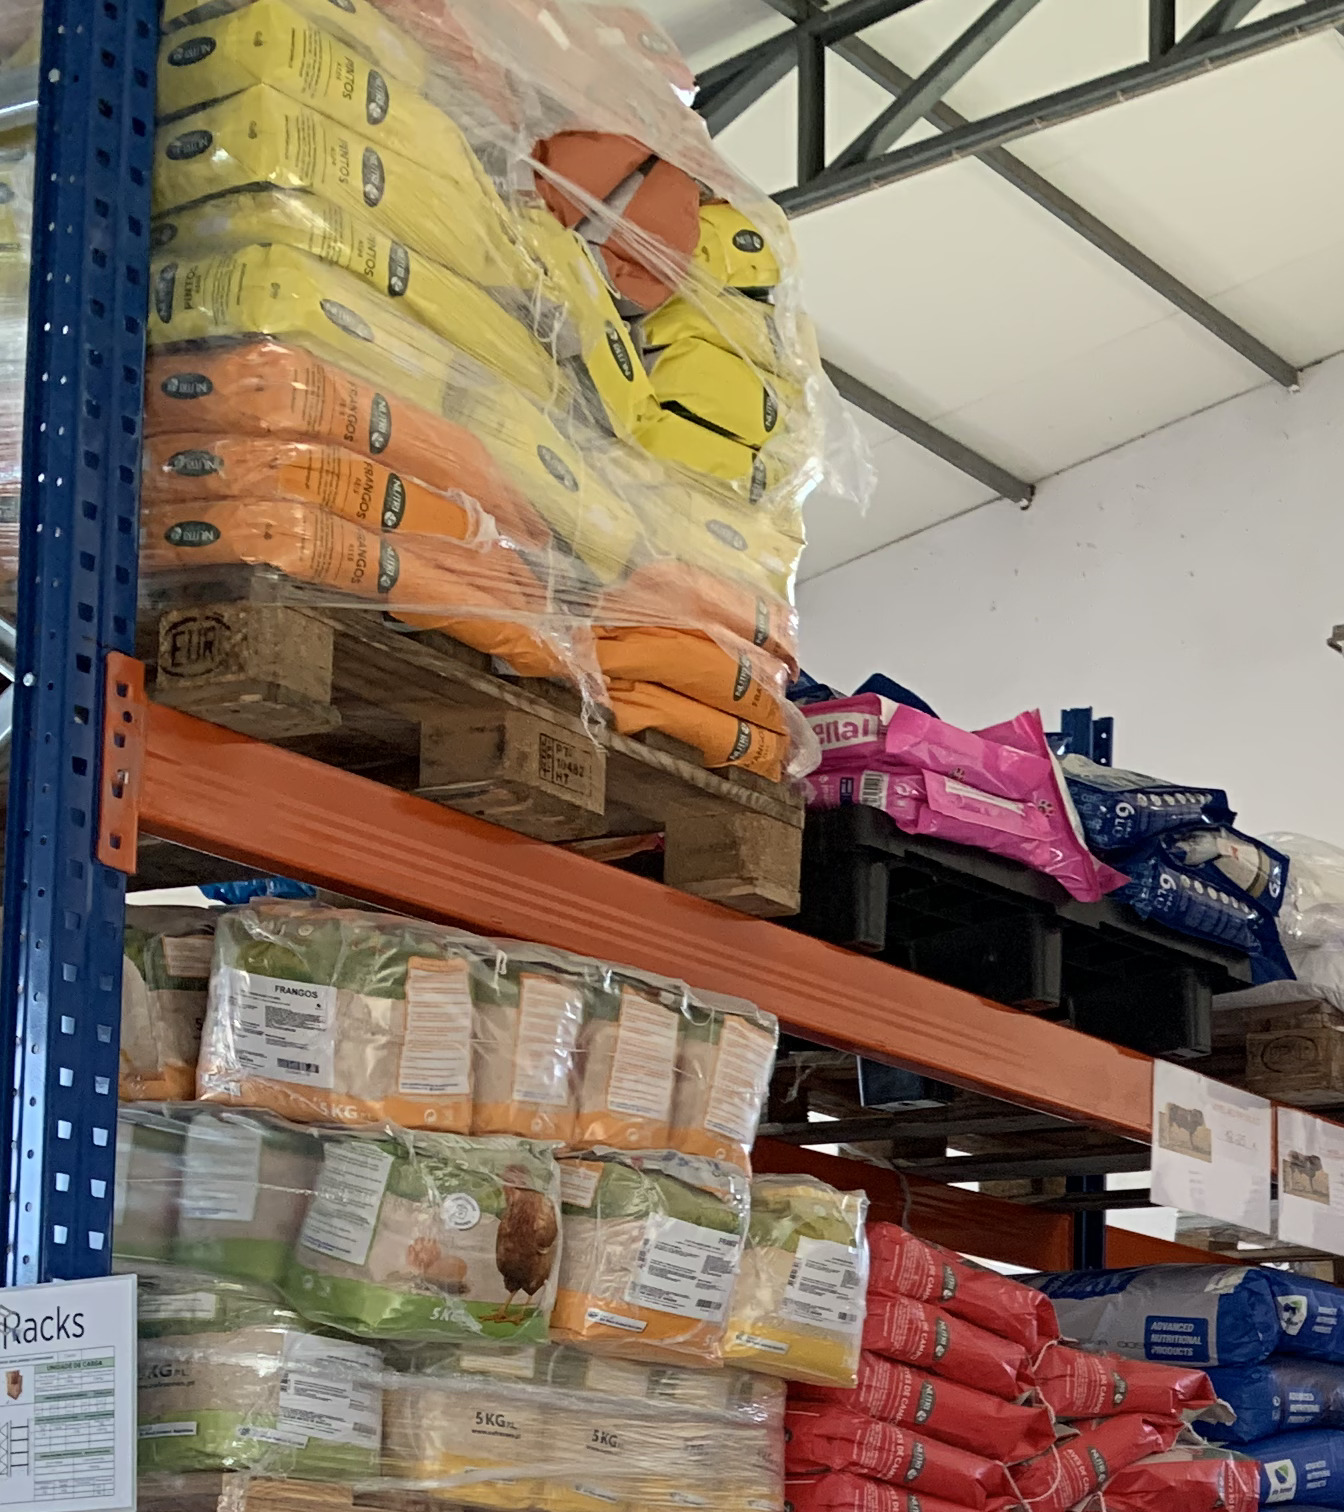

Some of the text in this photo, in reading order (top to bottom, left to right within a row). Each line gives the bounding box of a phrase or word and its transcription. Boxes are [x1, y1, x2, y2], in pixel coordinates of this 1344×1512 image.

[356, 461, 374, 520] FRANGOS
[386, 475, 401, 511] NUTRI
[275, 984, 319, 999] FRANGOS
[331, 1104, 358, 1119] KG
[3, 1305, 85, 1350] Racks
[1150, 1321, 1195, 1333] ADVANCED
[1150, 1333, 1203, 1347] NUTRITIONAL
[1150, 1345, 1194, 1357] PRODUCTS
[475, 1411, 506, 1428] 5 KG
